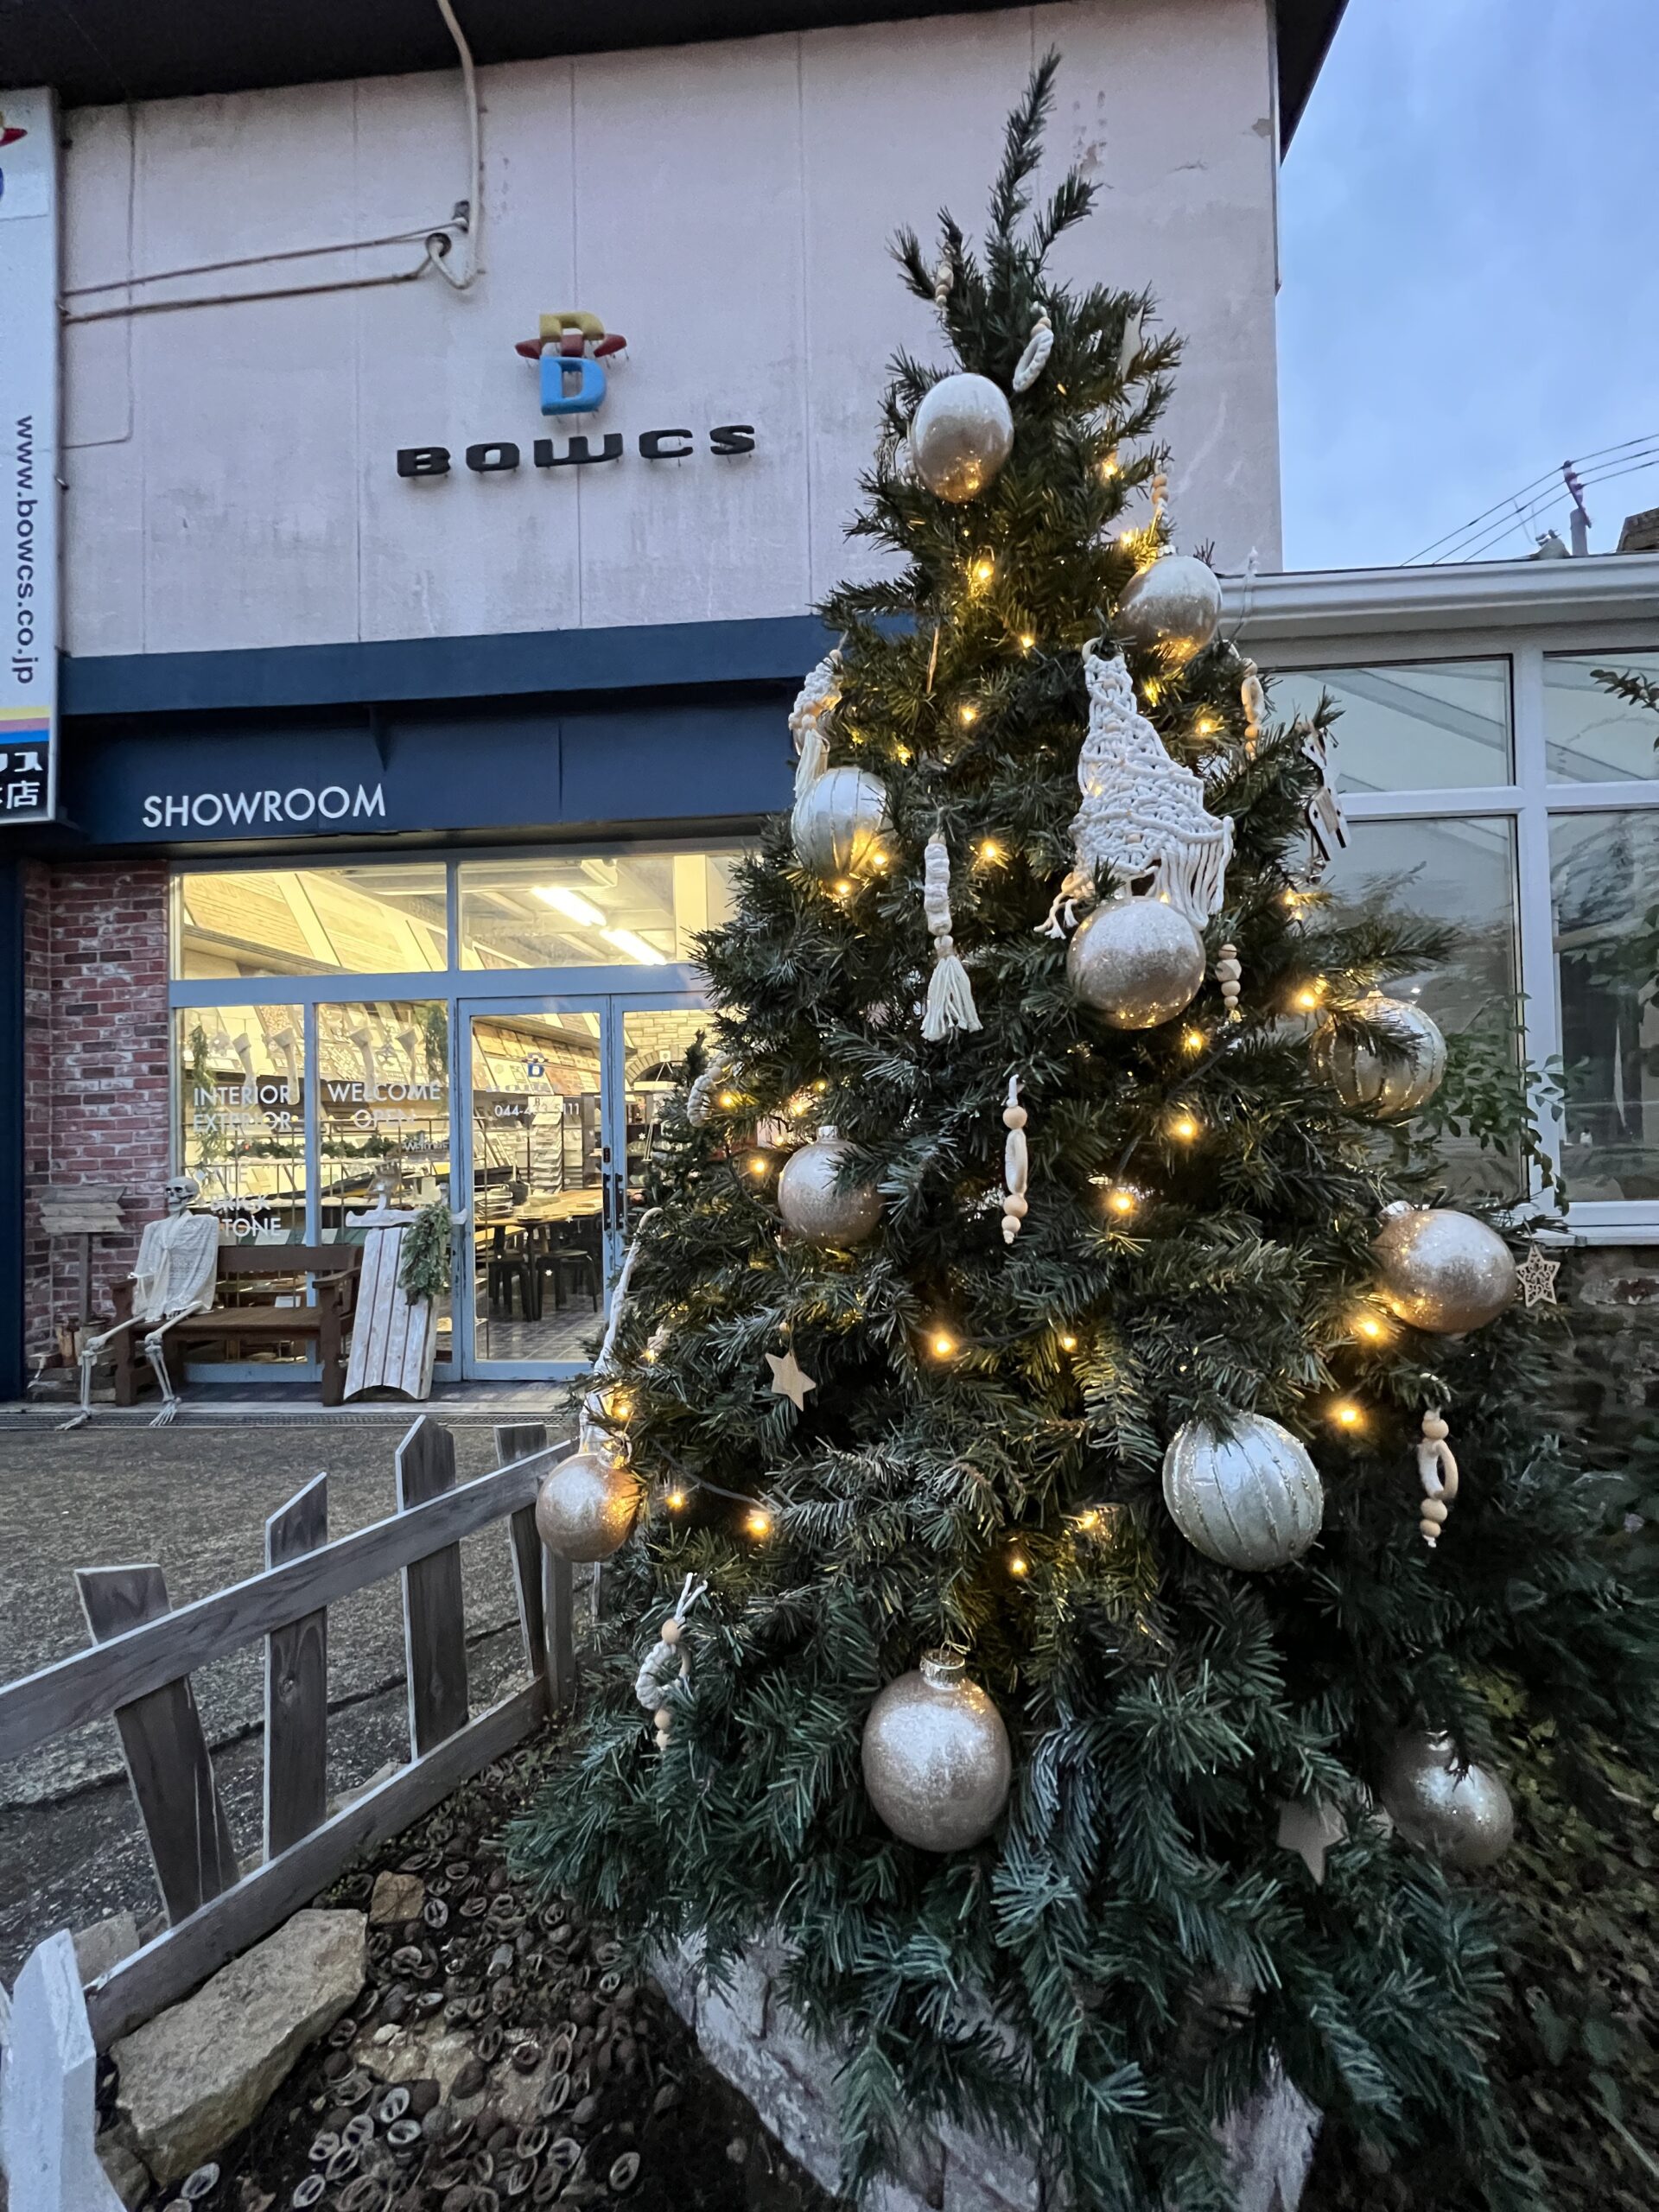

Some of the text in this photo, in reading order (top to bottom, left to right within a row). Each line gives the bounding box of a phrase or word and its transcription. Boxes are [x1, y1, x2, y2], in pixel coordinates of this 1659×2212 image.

[397, 424, 756, 477] BOWCS
[11, 415, 39, 684] www.bowcs.co.jp
[0, 780, 41, 809] 店
[143, 783, 385, 828] SHOWROOM
[194, 1084, 290, 1106] INTERIOR
[327, 1082, 441, 1103] WELCOME
[353, 1109, 415, 1128] OPEN
[220, 1217, 282, 1238] TONE
